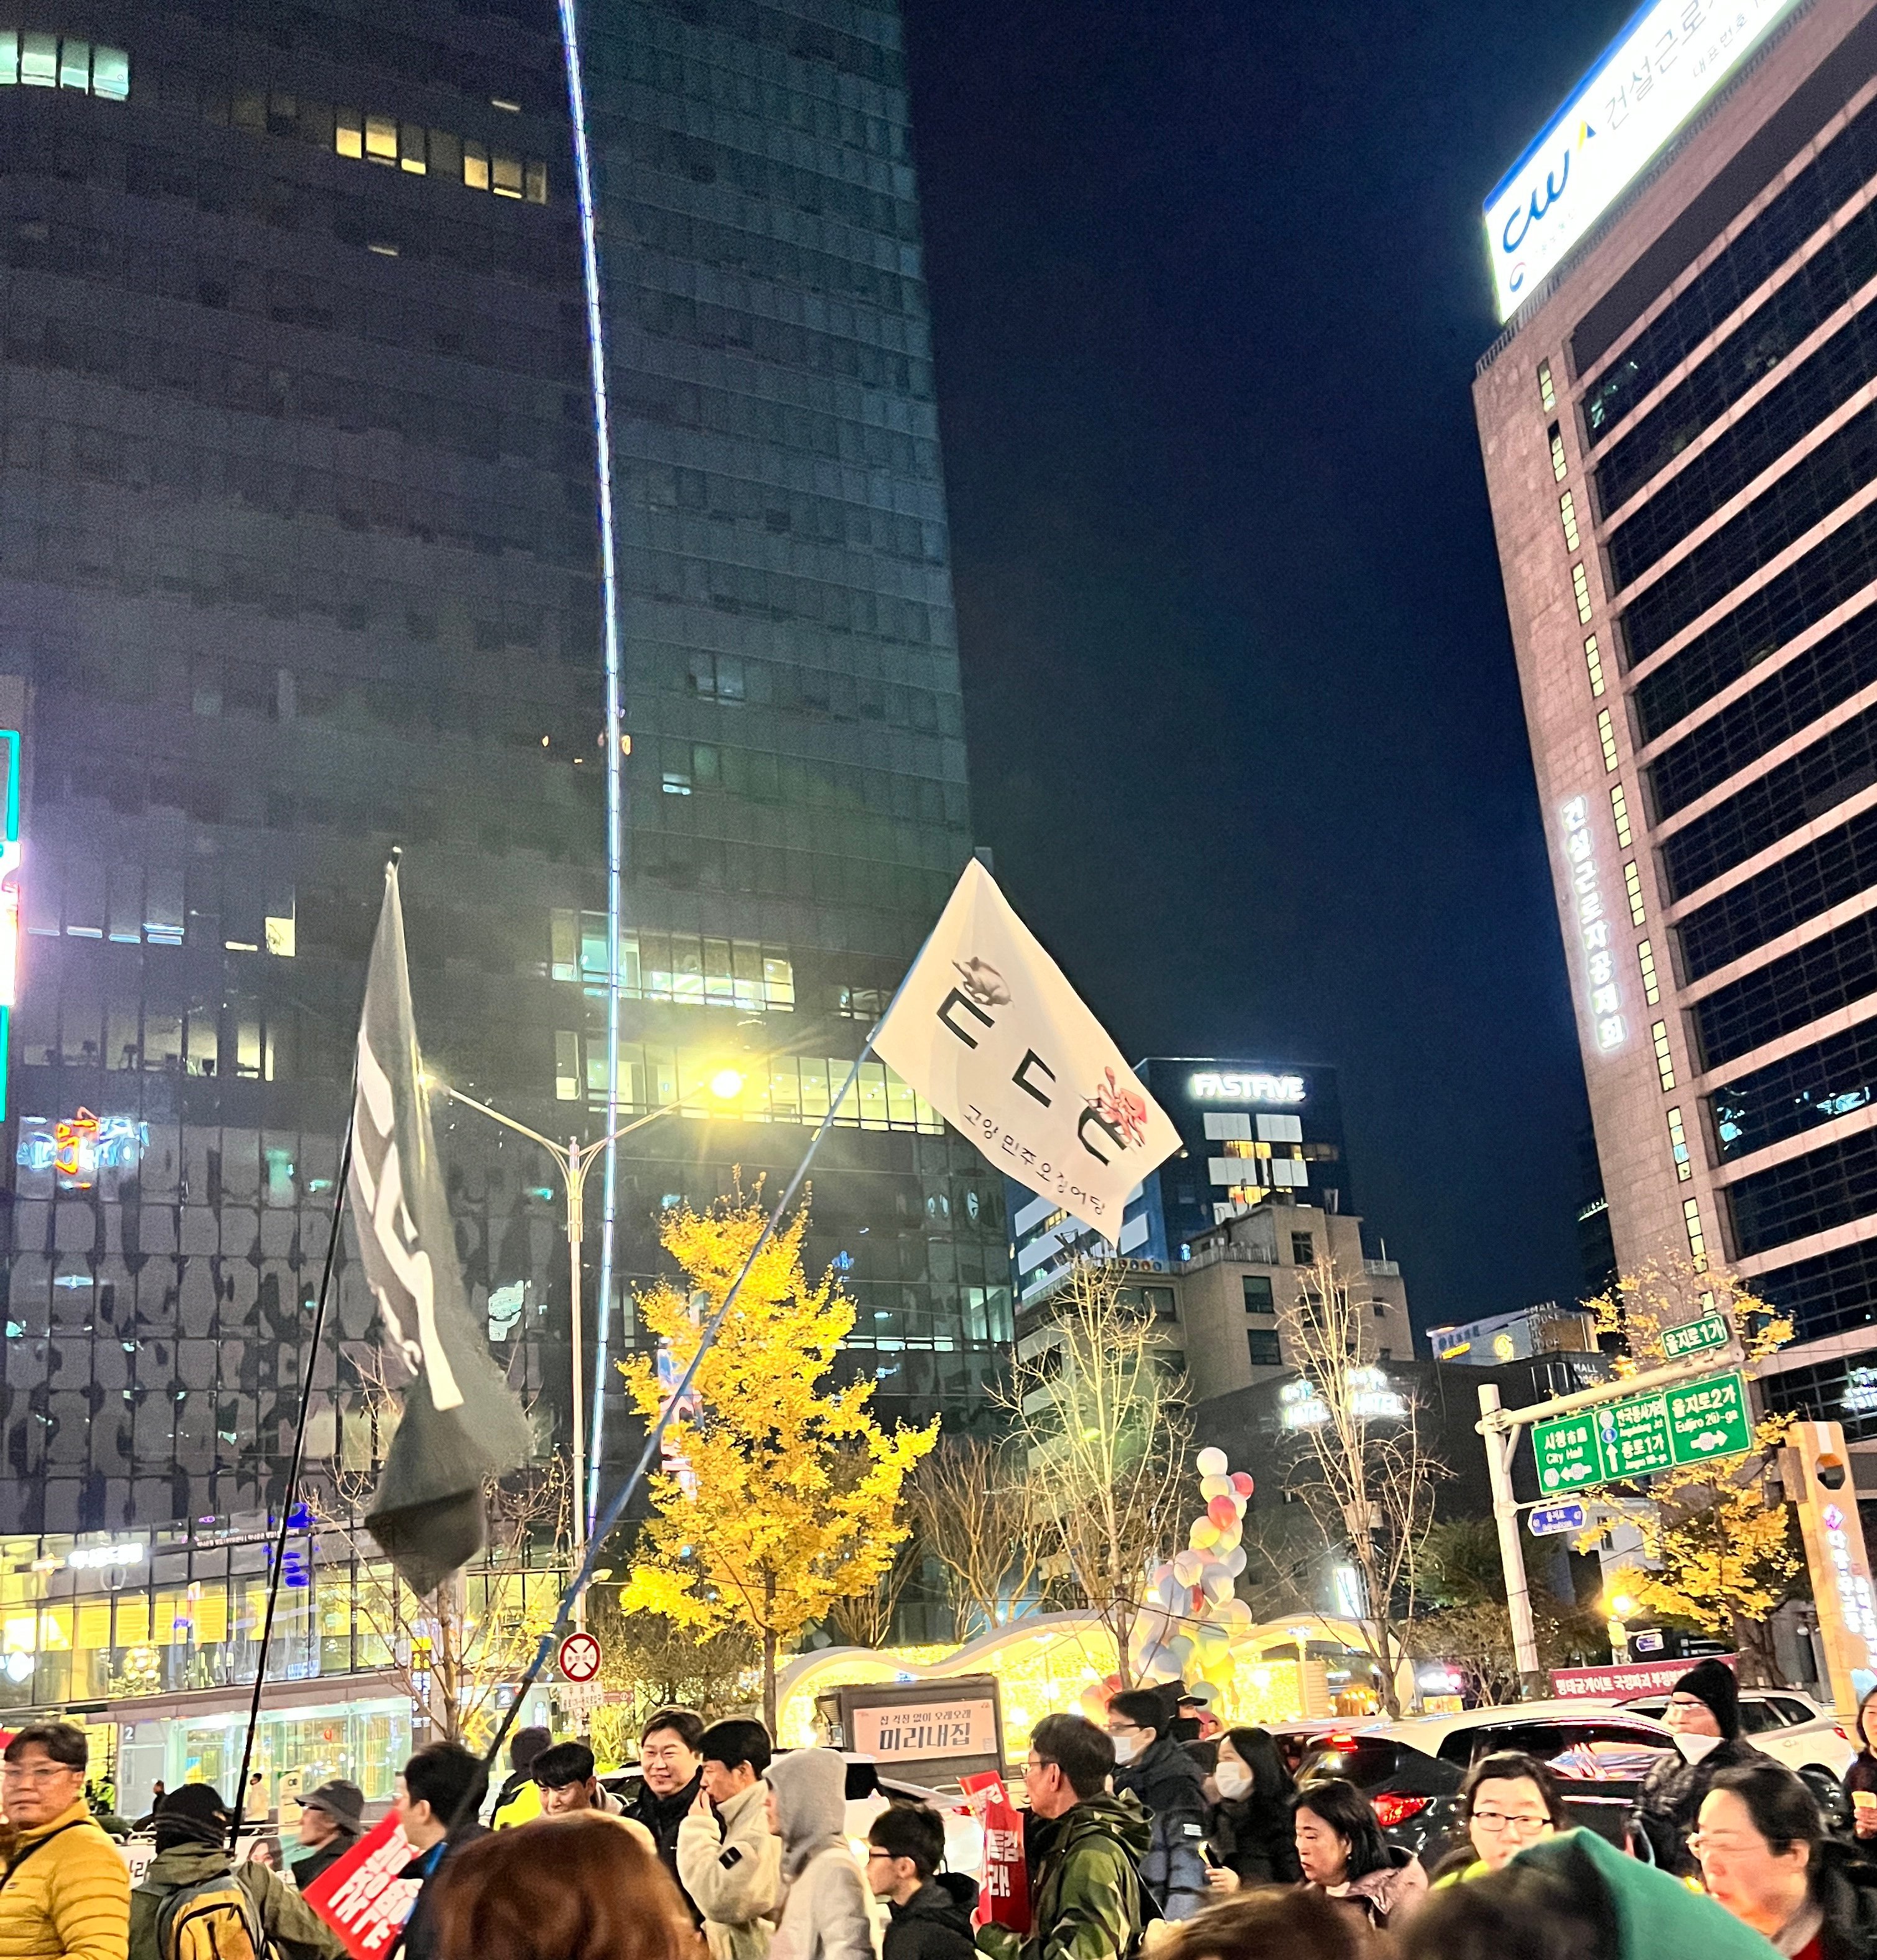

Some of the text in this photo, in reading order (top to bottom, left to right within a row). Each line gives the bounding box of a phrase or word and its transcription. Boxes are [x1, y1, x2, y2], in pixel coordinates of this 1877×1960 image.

[1605, 0, 1713, 131] 건설근로
[1193, 1073, 1306, 1100] FASTFIVE
[964, 1104, 998, 1139] 고양
[1524, 1300, 1559, 1315] SMALL
[1666, 1319, 1723, 1354] 을지로1가
[1573, 1363, 1598, 1373] MALL
[1672, 1384, 1736, 1418] 을지로2가
[1621, 1433, 1664, 1459] 종로1가
[1556, 1676, 1614, 1695] 명태균게이트
[1613, 1672, 1652, 1691] 국정파괴
[500, 1690, 511, 1705] 2
[880, 1709, 971, 1726] 집 걱정 없이 오래오래
[125, 1726, 134, 1740] 2
[880, 1722, 971, 1750] 미리내집
